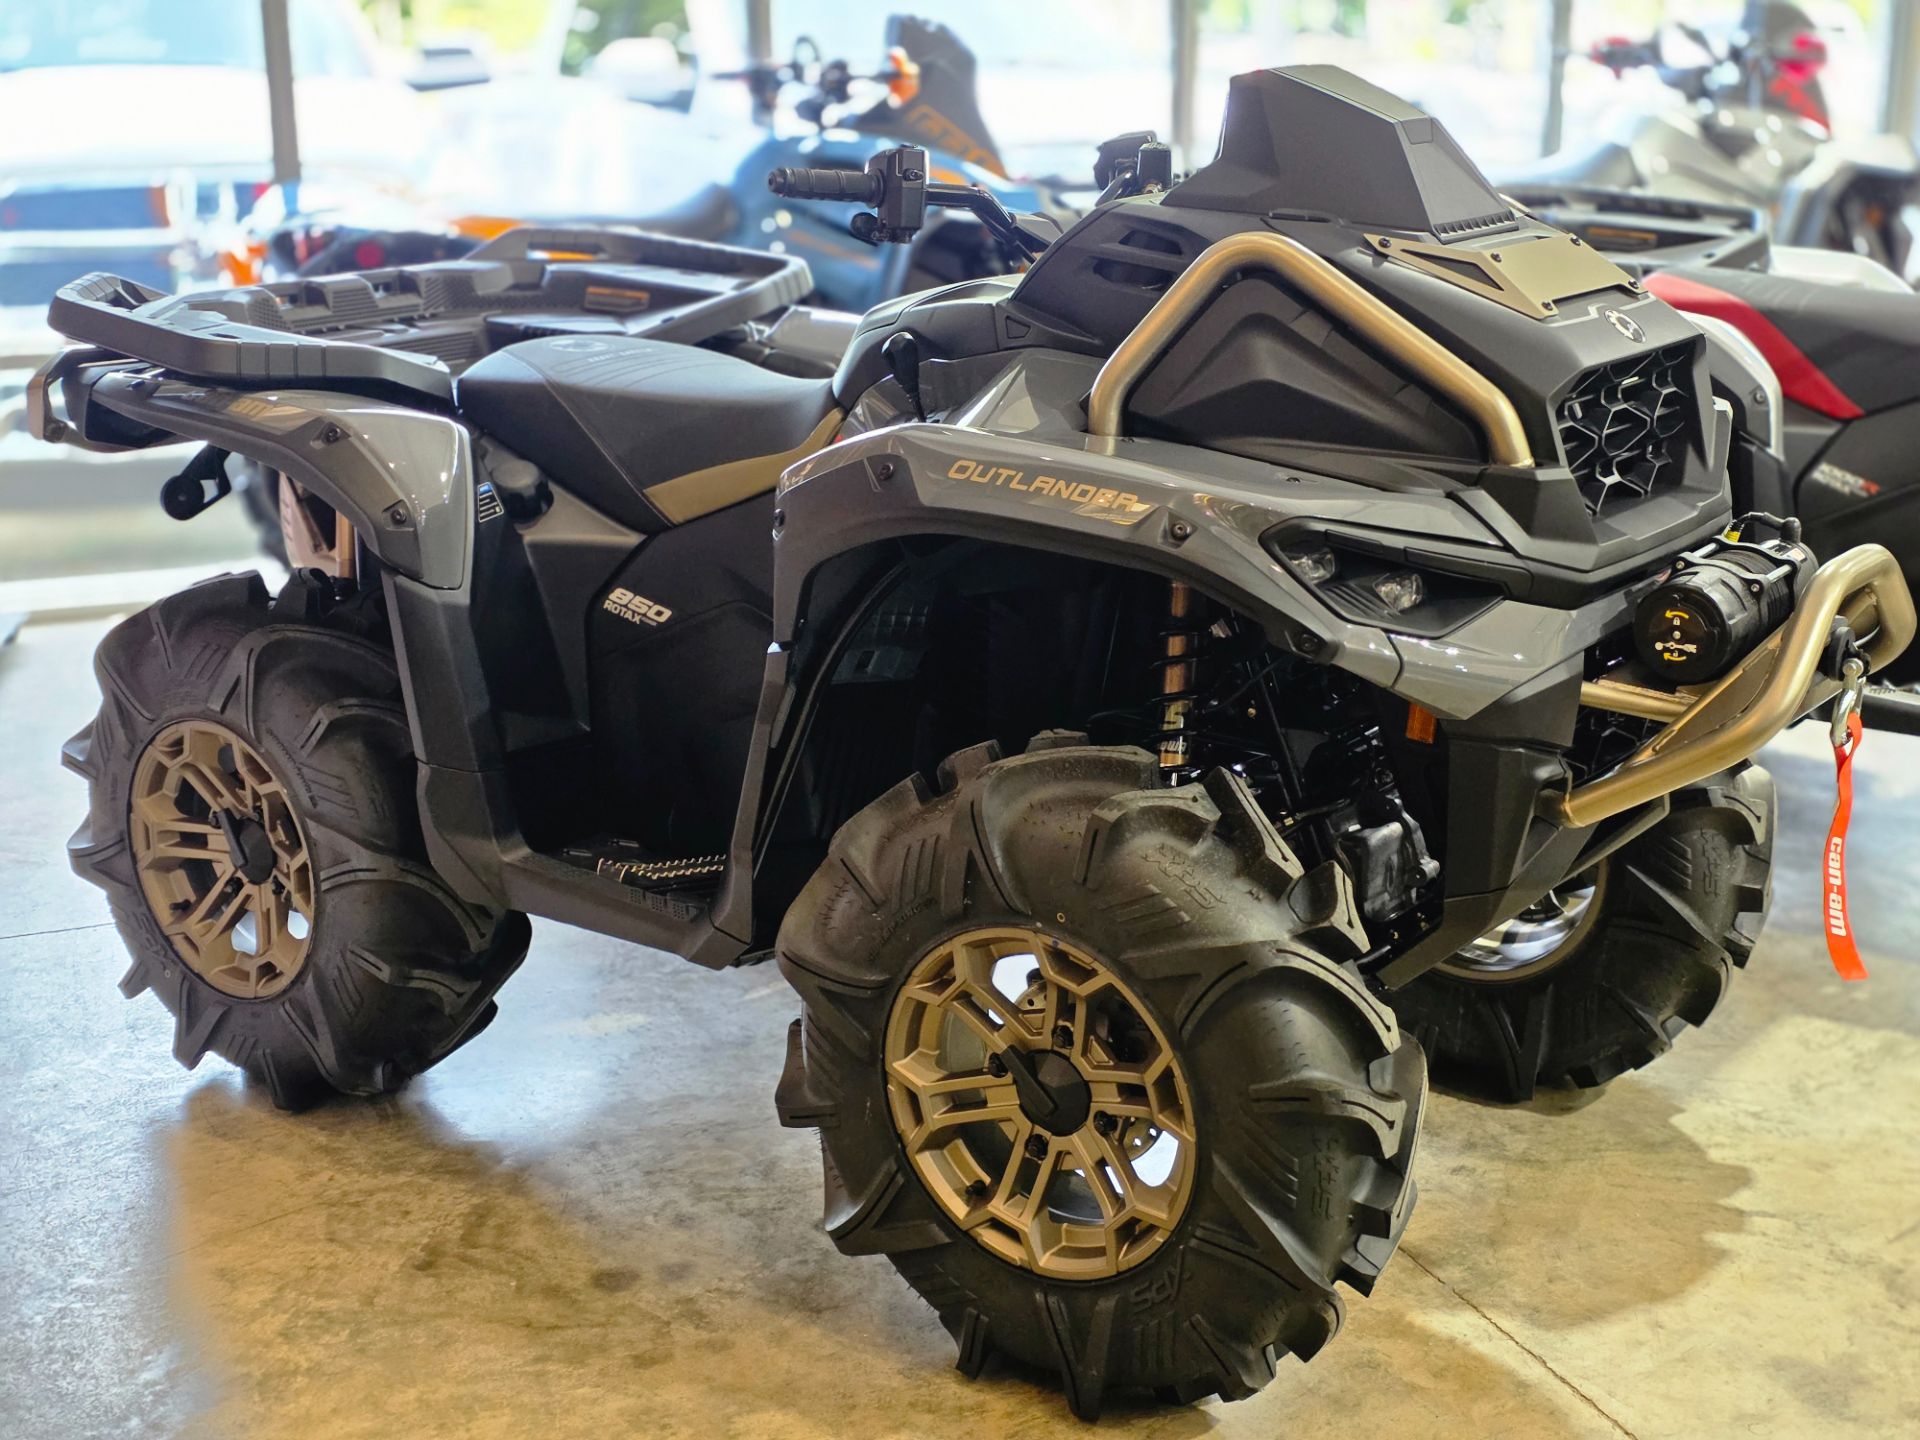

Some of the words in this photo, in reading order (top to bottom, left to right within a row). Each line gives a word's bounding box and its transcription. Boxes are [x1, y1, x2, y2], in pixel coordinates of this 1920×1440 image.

[947, 459, 1139, 512] OUTLANDER
[603, 599, 642, 625] ROTAX
[608, 587, 672, 623] 850
[1828, 836, 1847, 937] can-am
